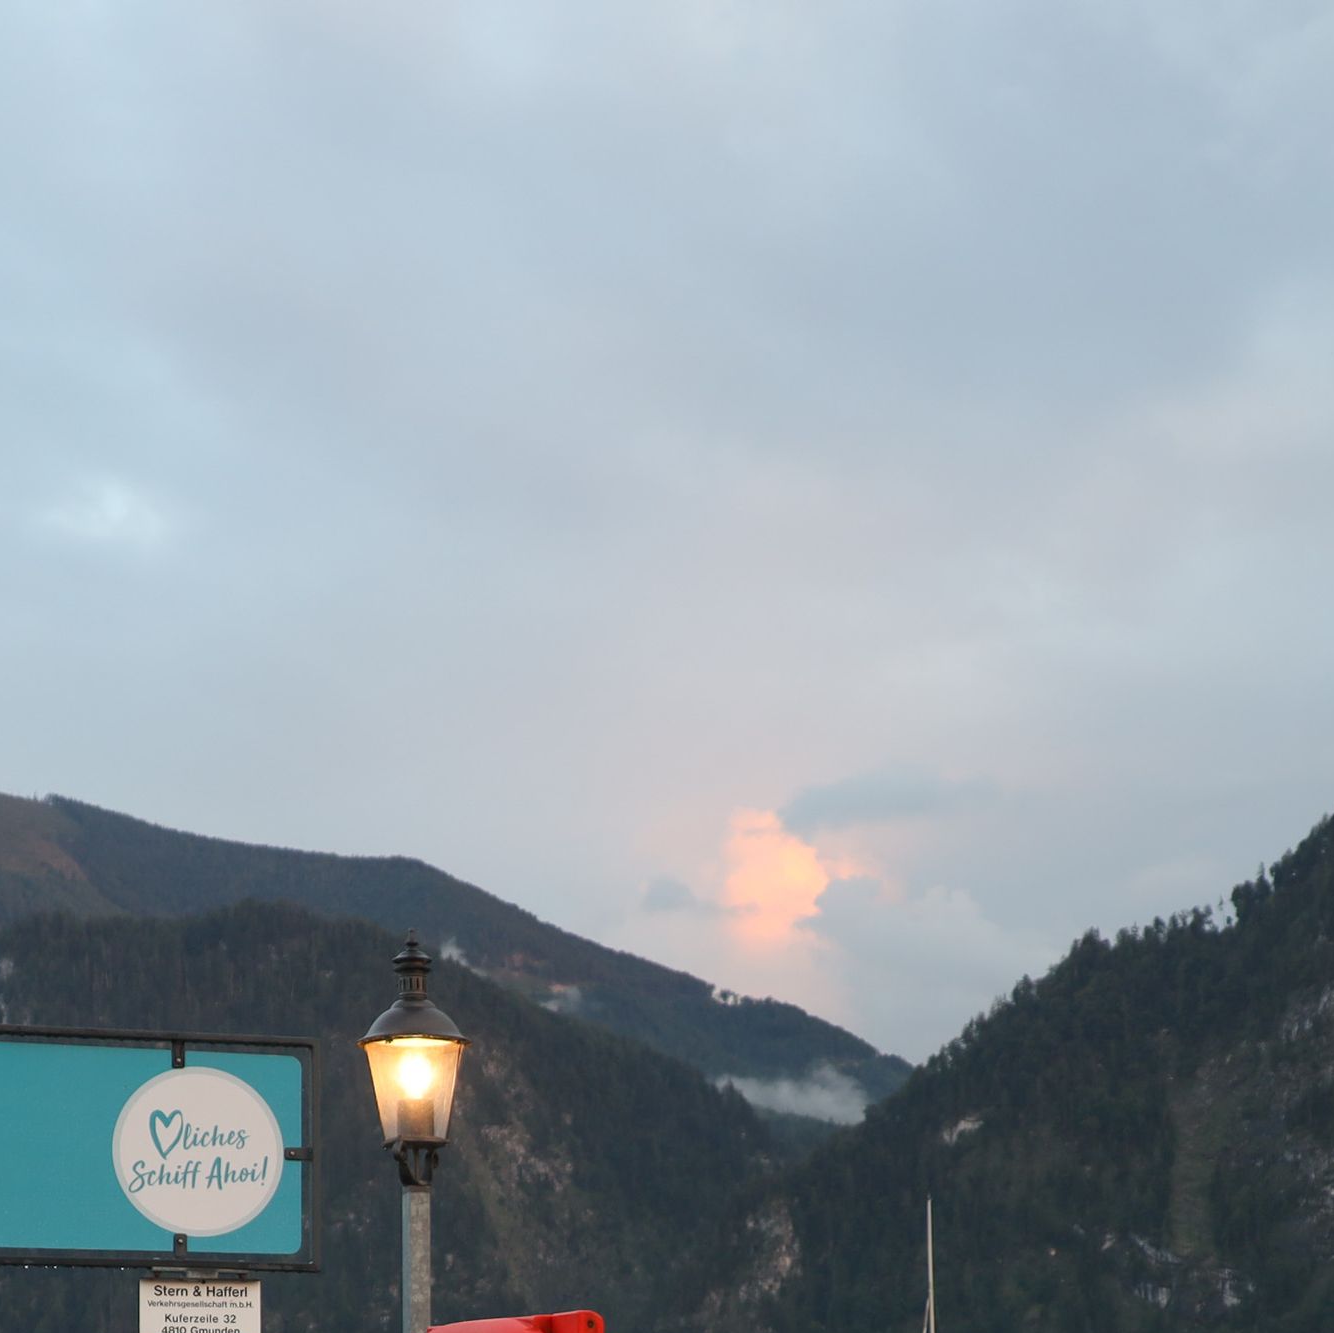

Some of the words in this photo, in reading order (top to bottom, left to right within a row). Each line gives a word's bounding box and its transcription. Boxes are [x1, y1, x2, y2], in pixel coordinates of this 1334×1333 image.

[128, 1160, 202, 1193] Schiff
[205, 1156, 268, 1190] Ahoi!
[154, 1285, 188, 1296] Stern
[193, 1286, 202, 1297] &
[206, 1286, 248, 1297] Hafferl
[165, 1314, 218, 1323] Kuferzeile
[223, 1314, 236, 1323] 32
